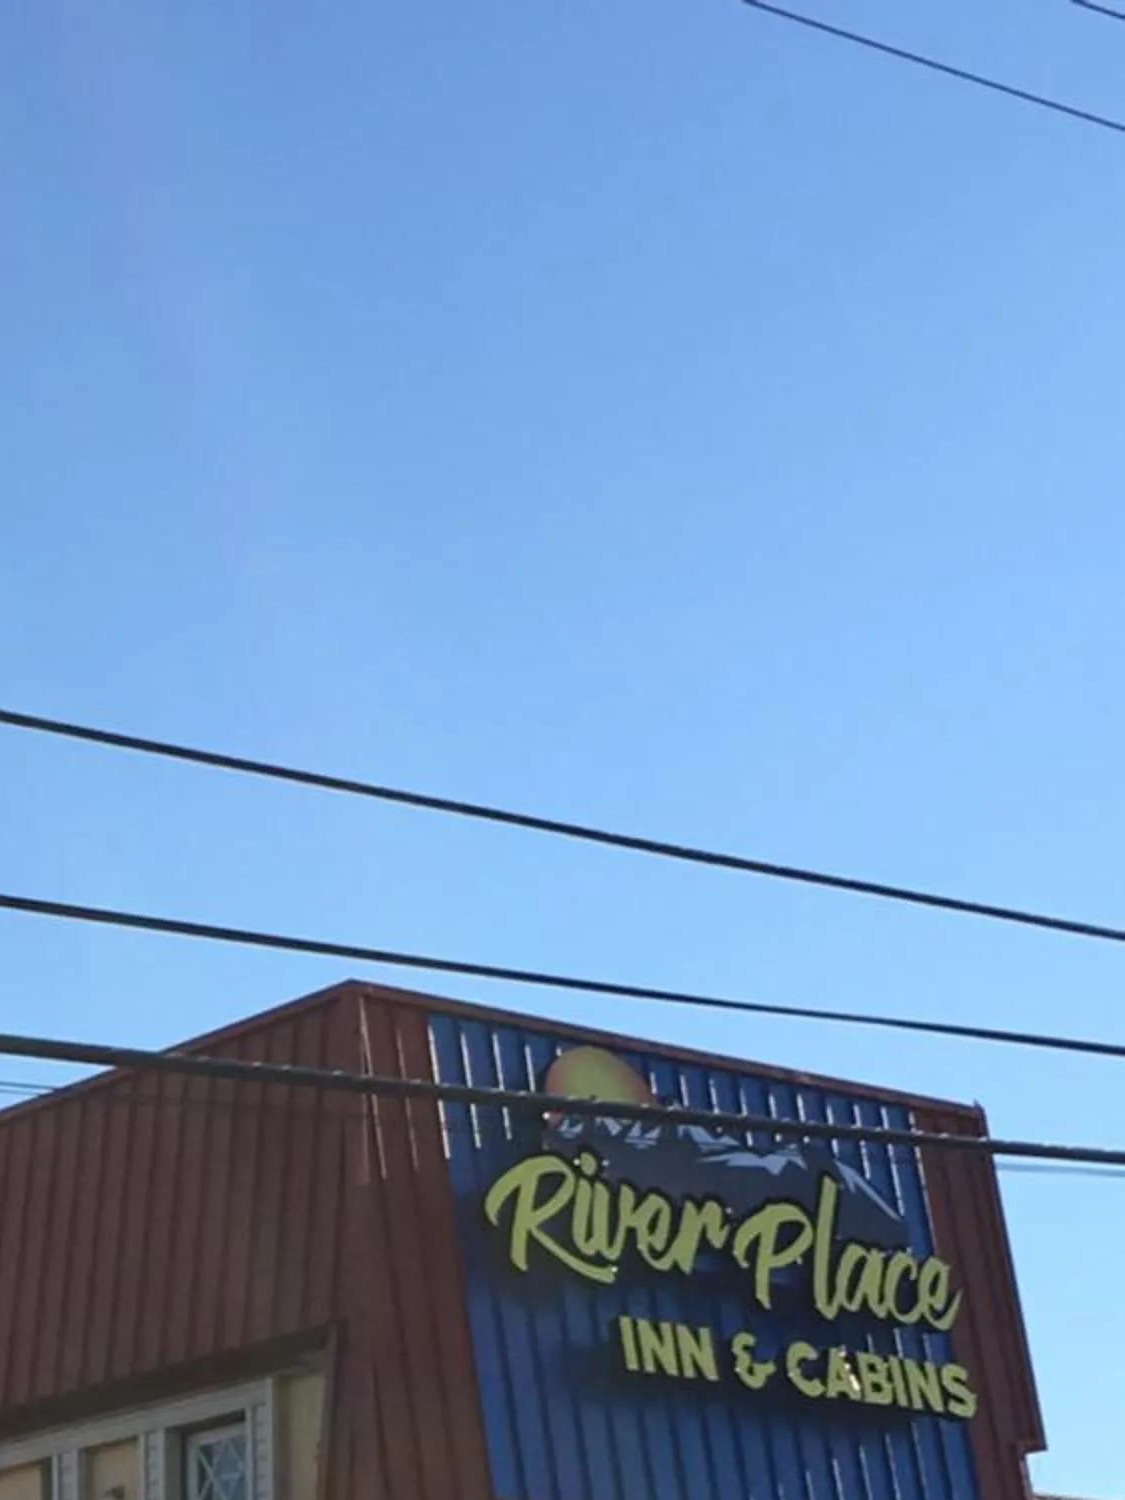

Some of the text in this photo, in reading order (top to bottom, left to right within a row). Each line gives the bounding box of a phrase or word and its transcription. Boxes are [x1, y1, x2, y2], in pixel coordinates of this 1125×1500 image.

[484, 1152, 963, 1331] River Place
[619, 1315, 977, 1419] INN & CABINS
